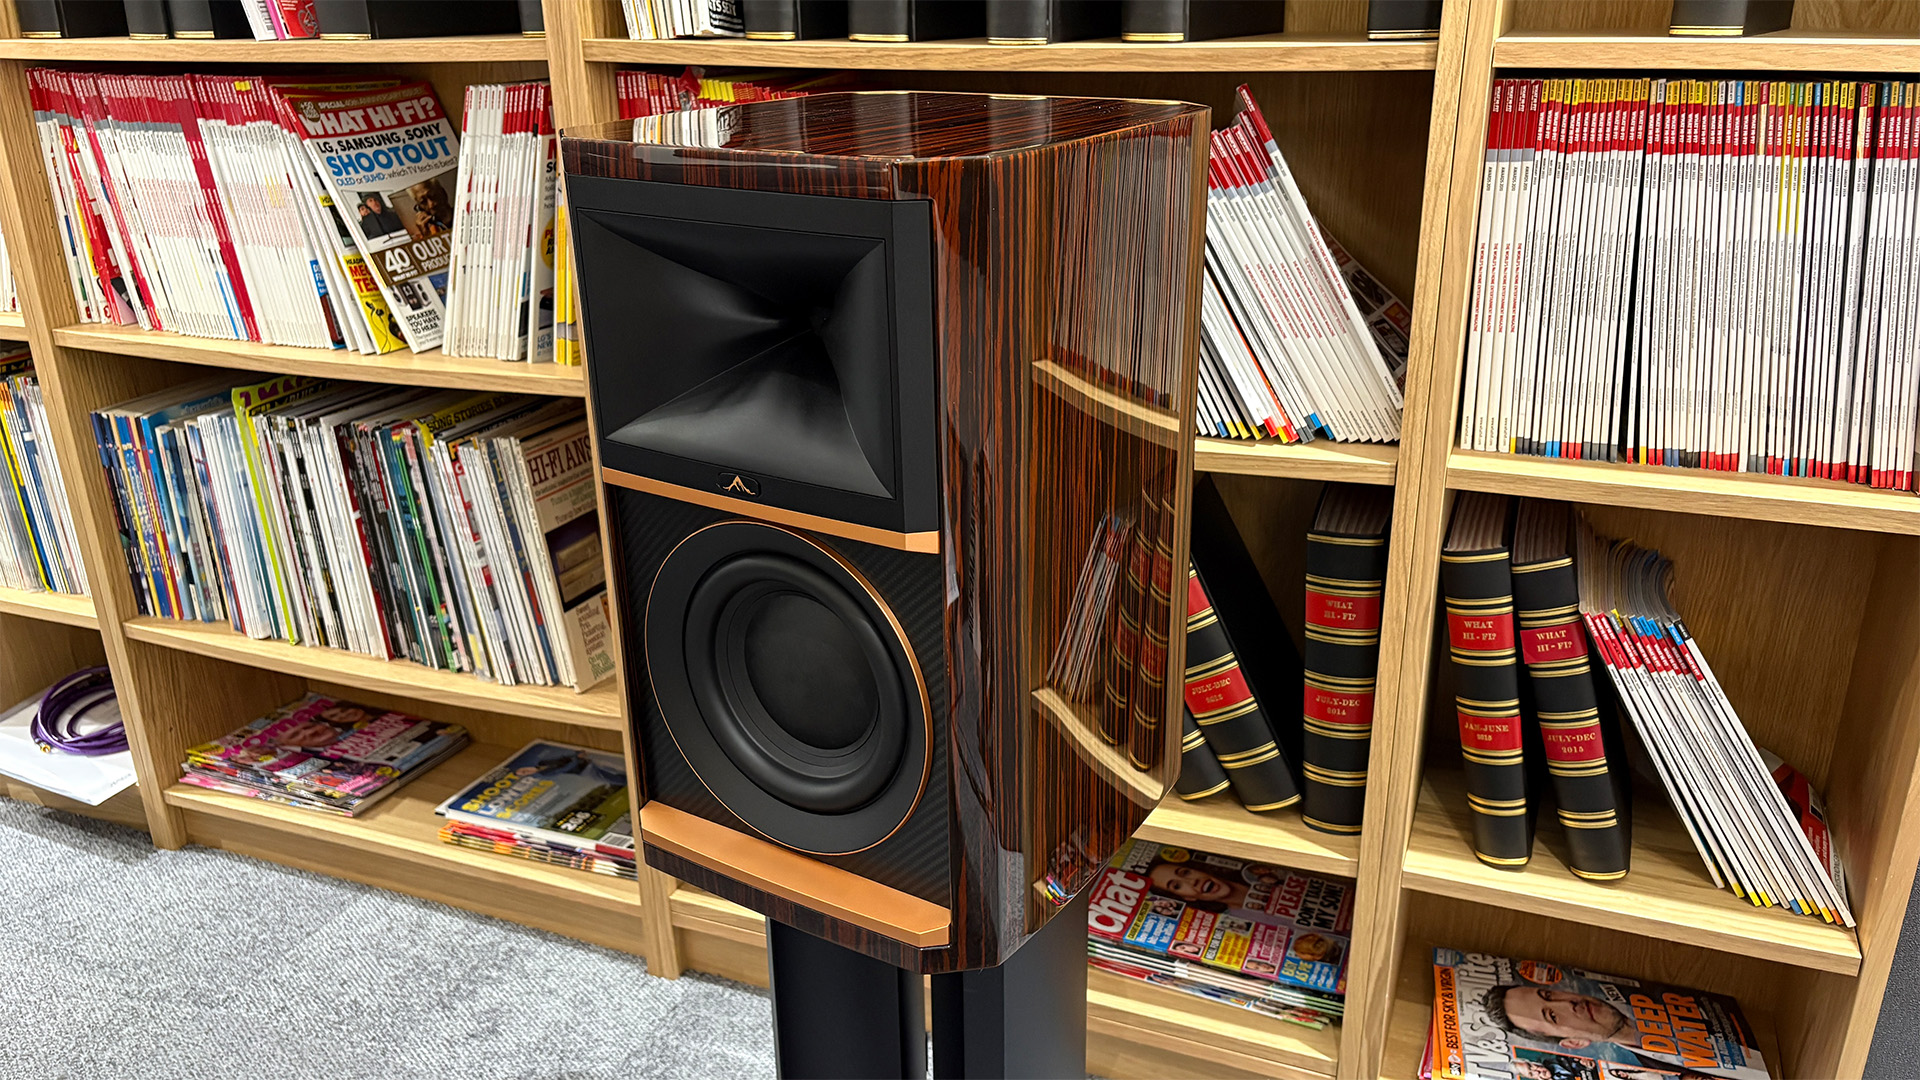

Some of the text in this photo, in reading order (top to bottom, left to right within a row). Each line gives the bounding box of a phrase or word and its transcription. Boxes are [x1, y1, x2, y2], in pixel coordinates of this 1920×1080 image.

[318, 101, 345, 109] SPECIAL
[298, 108, 368, 136] WHAT
[404, 123, 441, 142] SONY
[326, 136, 452, 177] SHOOTOUT
[336, 177, 356, 186] OLED
[407, 165, 418, 175] TV
[385, 248, 410, 273] 40
[412, 238, 444, 261] OUR
[406, 309, 437, 322] SPEAKERS
[409, 315, 441, 328] YOU HAVE
[412, 322, 439, 334] TO HEAR
[426, 414, 453, 433] SONG
[453, 399, 493, 424] STORIES
[1326, 600, 1353, 610] WHAT
[1464, 620, 1494, 628] WHAT
[1536, 630, 1567, 640] WHAT
[461, 772, 521, 812] SHOOT
[478, 776, 539, 816] LOWER
[1088, 870, 1146, 933] Chat
[1276, 876, 1308, 918] PLEASE
[1296, 878, 1325, 927] DON'T TAKE
[1313, 882, 1344, 930] MY SON!
[1281, 959, 1298, 977] EASY
[1298, 961, 1313, 974] PIE
[1440, 968, 1452, 991] VIRGIN
[1443, 998, 1457, 1014] SKY
[1445, 1014, 1457, 1029] FOR
[1630, 994, 1678, 1054] DEEP
[1662, 992, 1718, 1068] WATER
[1447, 1030, 1459, 1049] BEST
